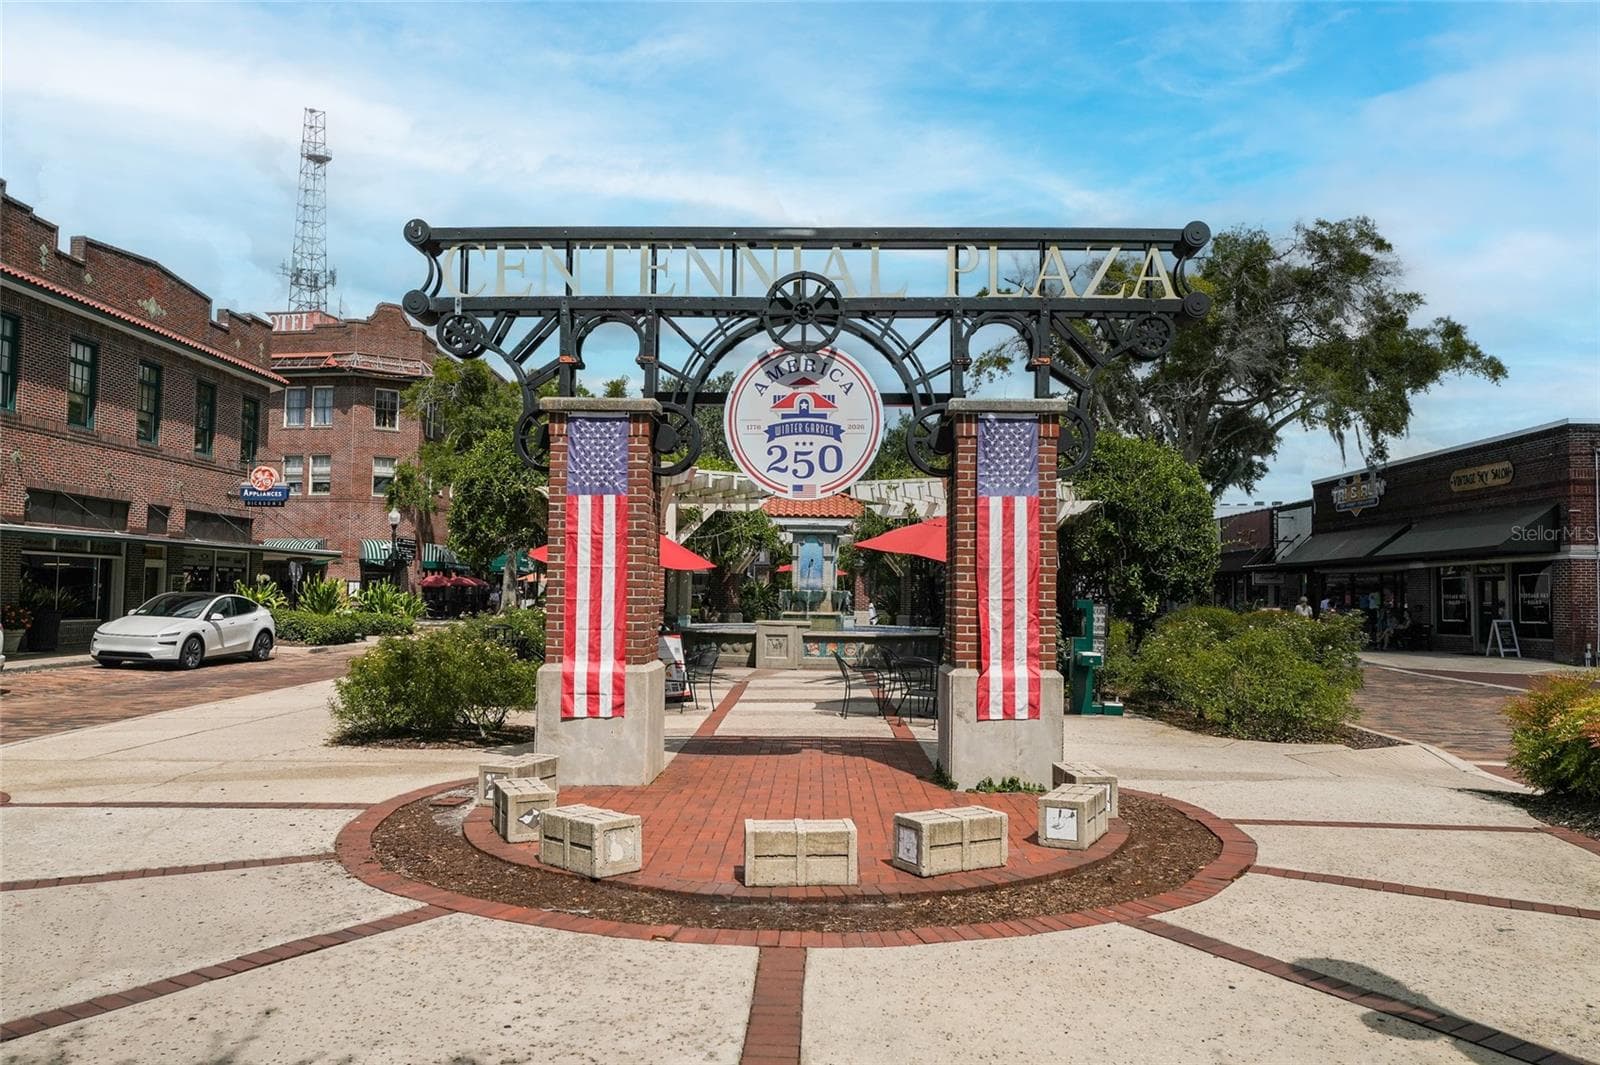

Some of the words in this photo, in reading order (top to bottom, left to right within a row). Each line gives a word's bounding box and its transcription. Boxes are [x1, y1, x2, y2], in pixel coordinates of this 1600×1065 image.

[442, 241, 908, 298] CENTENNIAL
[944, 242, 1183, 299] PLAZA
[754, 358, 855, 397] AMERICA
[774, 423, 803, 436] WINTER
[804, 421, 834, 436] GARDEN
[766, 444, 843, 479] 250
